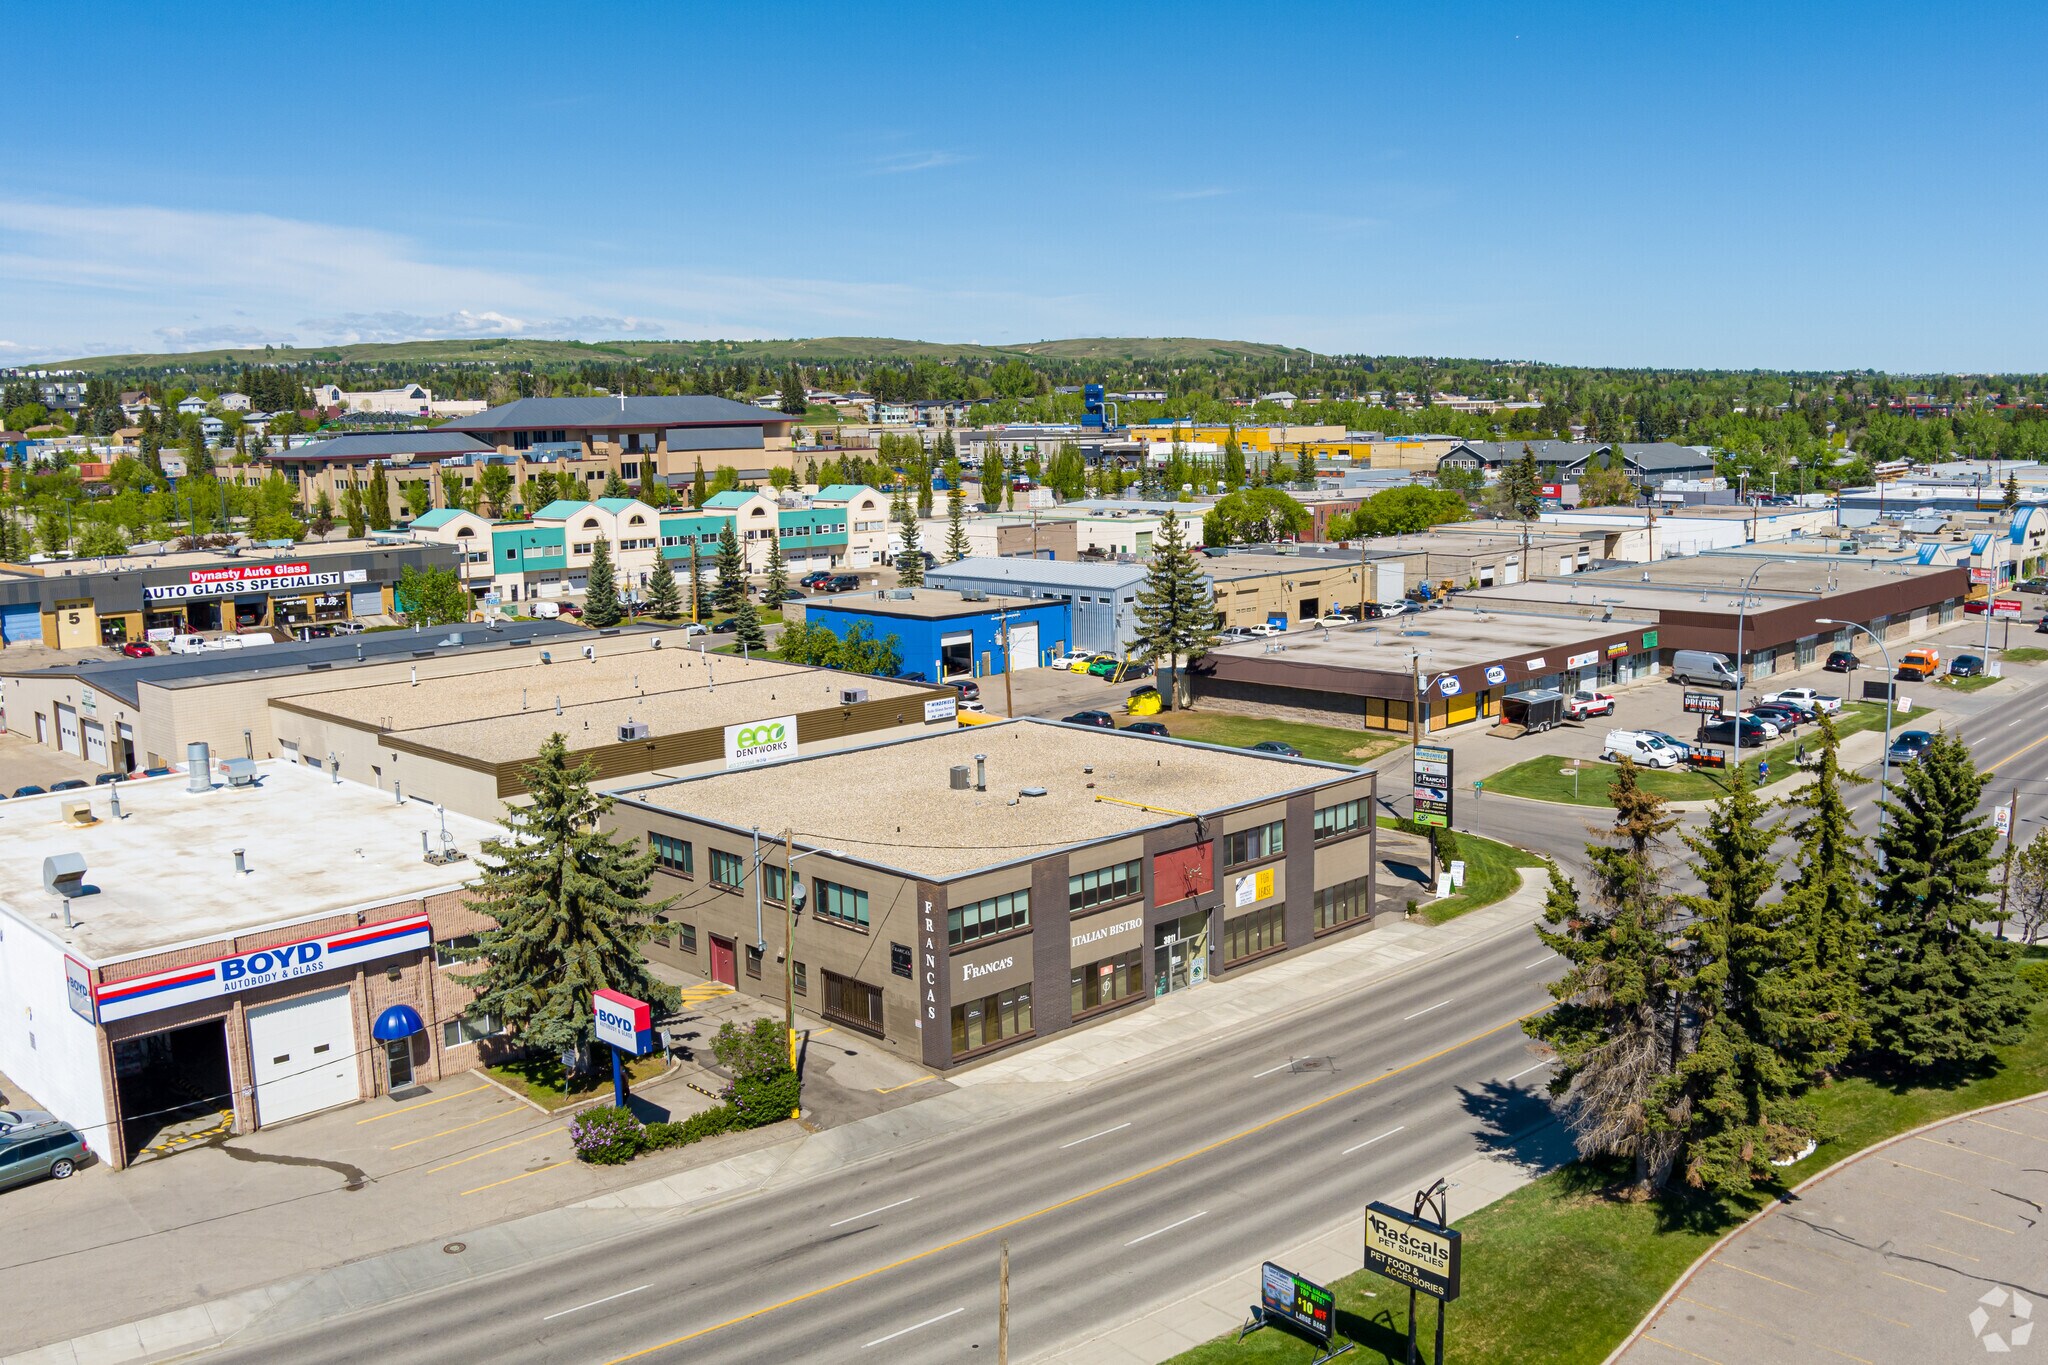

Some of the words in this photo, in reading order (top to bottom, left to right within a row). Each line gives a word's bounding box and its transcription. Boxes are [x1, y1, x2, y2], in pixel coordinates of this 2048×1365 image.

[191, 570, 241, 583] Dynasty
[244, 567, 272, 578] Auto
[274, 564, 308, 575] Glass
[143, 585, 187, 599] AUTO
[193, 582, 245, 595] GLASS
[250, 573, 339, 590] SPECIALIST
[68, 612, 81, 625] 5
[1489, 670, 1502, 678] BASE
[1442, 681, 1456, 689] BASE
[931, 698, 955, 707] WINDSHIELD
[1685, 698, 1720, 711] PRINTERS
[737, 723, 785, 748] eco
[736, 742, 788, 758] DENTWORKS
[1416, 751, 1447, 760] WINDSHIELD
[1422, 774, 1445, 784] FRANCA'S
[1260, 872, 1270, 884] FOR
[1258, 885, 1271, 898] LEASE
[1071, 927, 1109, 948] ITALIAN
[1109, 917, 1143, 936] BISTRO
[221, 942, 322, 981] BOYD
[924, 900, 936, 1019] FRANCAS
[962, 956, 1013, 982] FRANCA'S
[70, 976, 88, 996] BOYD
[224, 972, 278, 992] AUTOBODY
[282, 969, 288, 978] &
[292, 961, 324, 976] GLASS
[598, 1008, 632, 1032] BOYD
[599, 1021, 617, 1033] AUTOBODY
[1376, 1219, 1449, 1261] Rascals
[1378, 1236, 1396, 1249] PET
[1398, 1245, 1444, 1268] SUPPLIES
[1370, 1250, 1386, 1263] PET
[1387, 1257, 1411, 1272] FOOD
[1412, 1267, 1419, 1276] &
[1385, 1266, 1445, 1295] ACCESSORIES
[1300, 1288, 1310, 1297] TOP
[1297, 1297, 1314, 1315] $10
[1314, 1308, 1327, 1321] OFF
[1295, 1311, 1312, 1326] LARGE
[1312, 1319, 1327, 1332] BAGS
